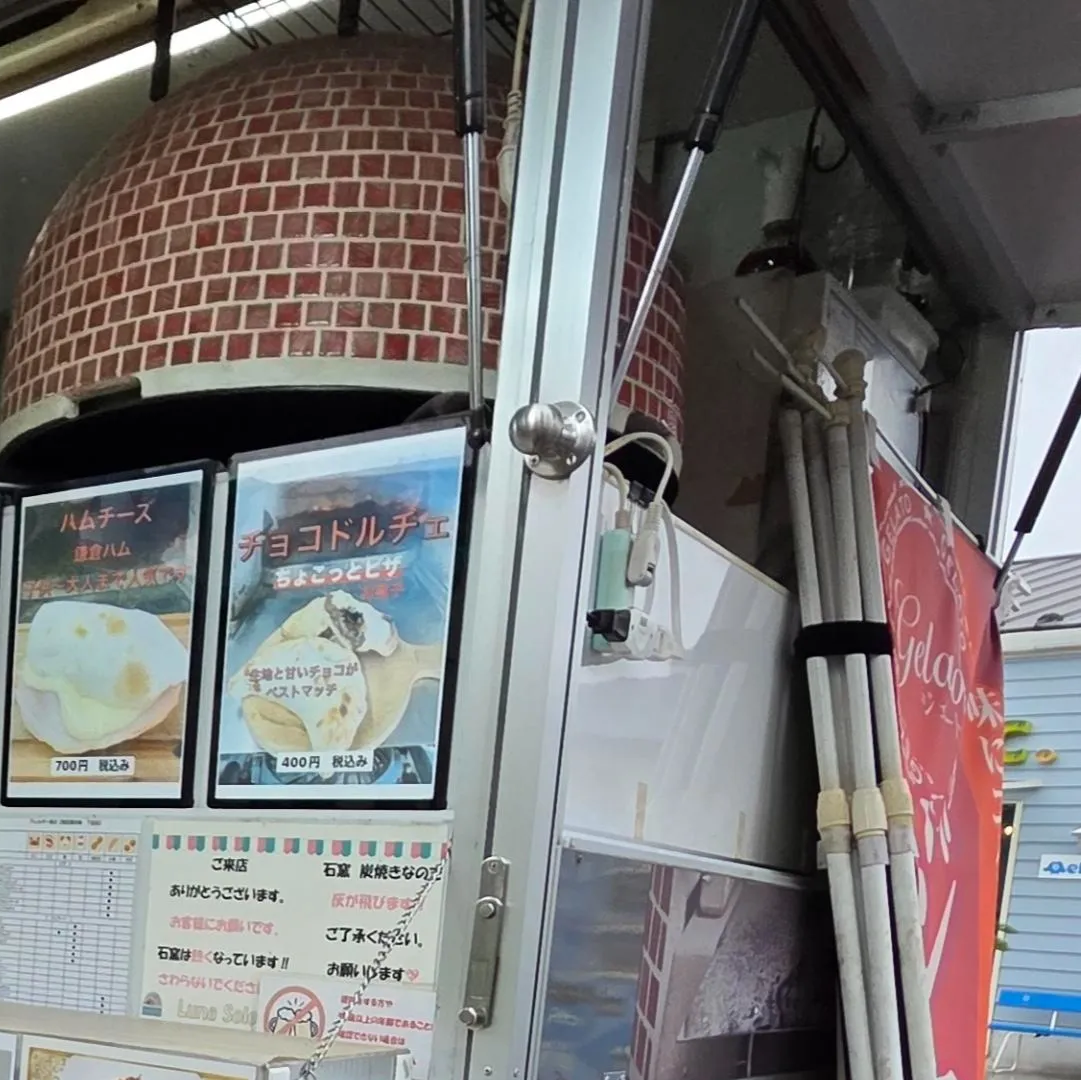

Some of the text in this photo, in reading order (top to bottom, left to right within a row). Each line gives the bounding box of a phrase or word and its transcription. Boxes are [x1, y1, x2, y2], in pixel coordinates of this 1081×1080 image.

[59, 502, 153, 532] ハムチーズ
[238, 506, 451, 562] チョコドルチェ
[74, 542, 131, 563] 鎌倉ハム
[55, 759, 130, 773] 700円 税込み
[281, 754, 368, 768] 400円 税込み
[211, 857, 249, 873] ご来店
[323, 862, 351, 878] 石窯
[169, 884, 285, 904] ありがとうございます。
